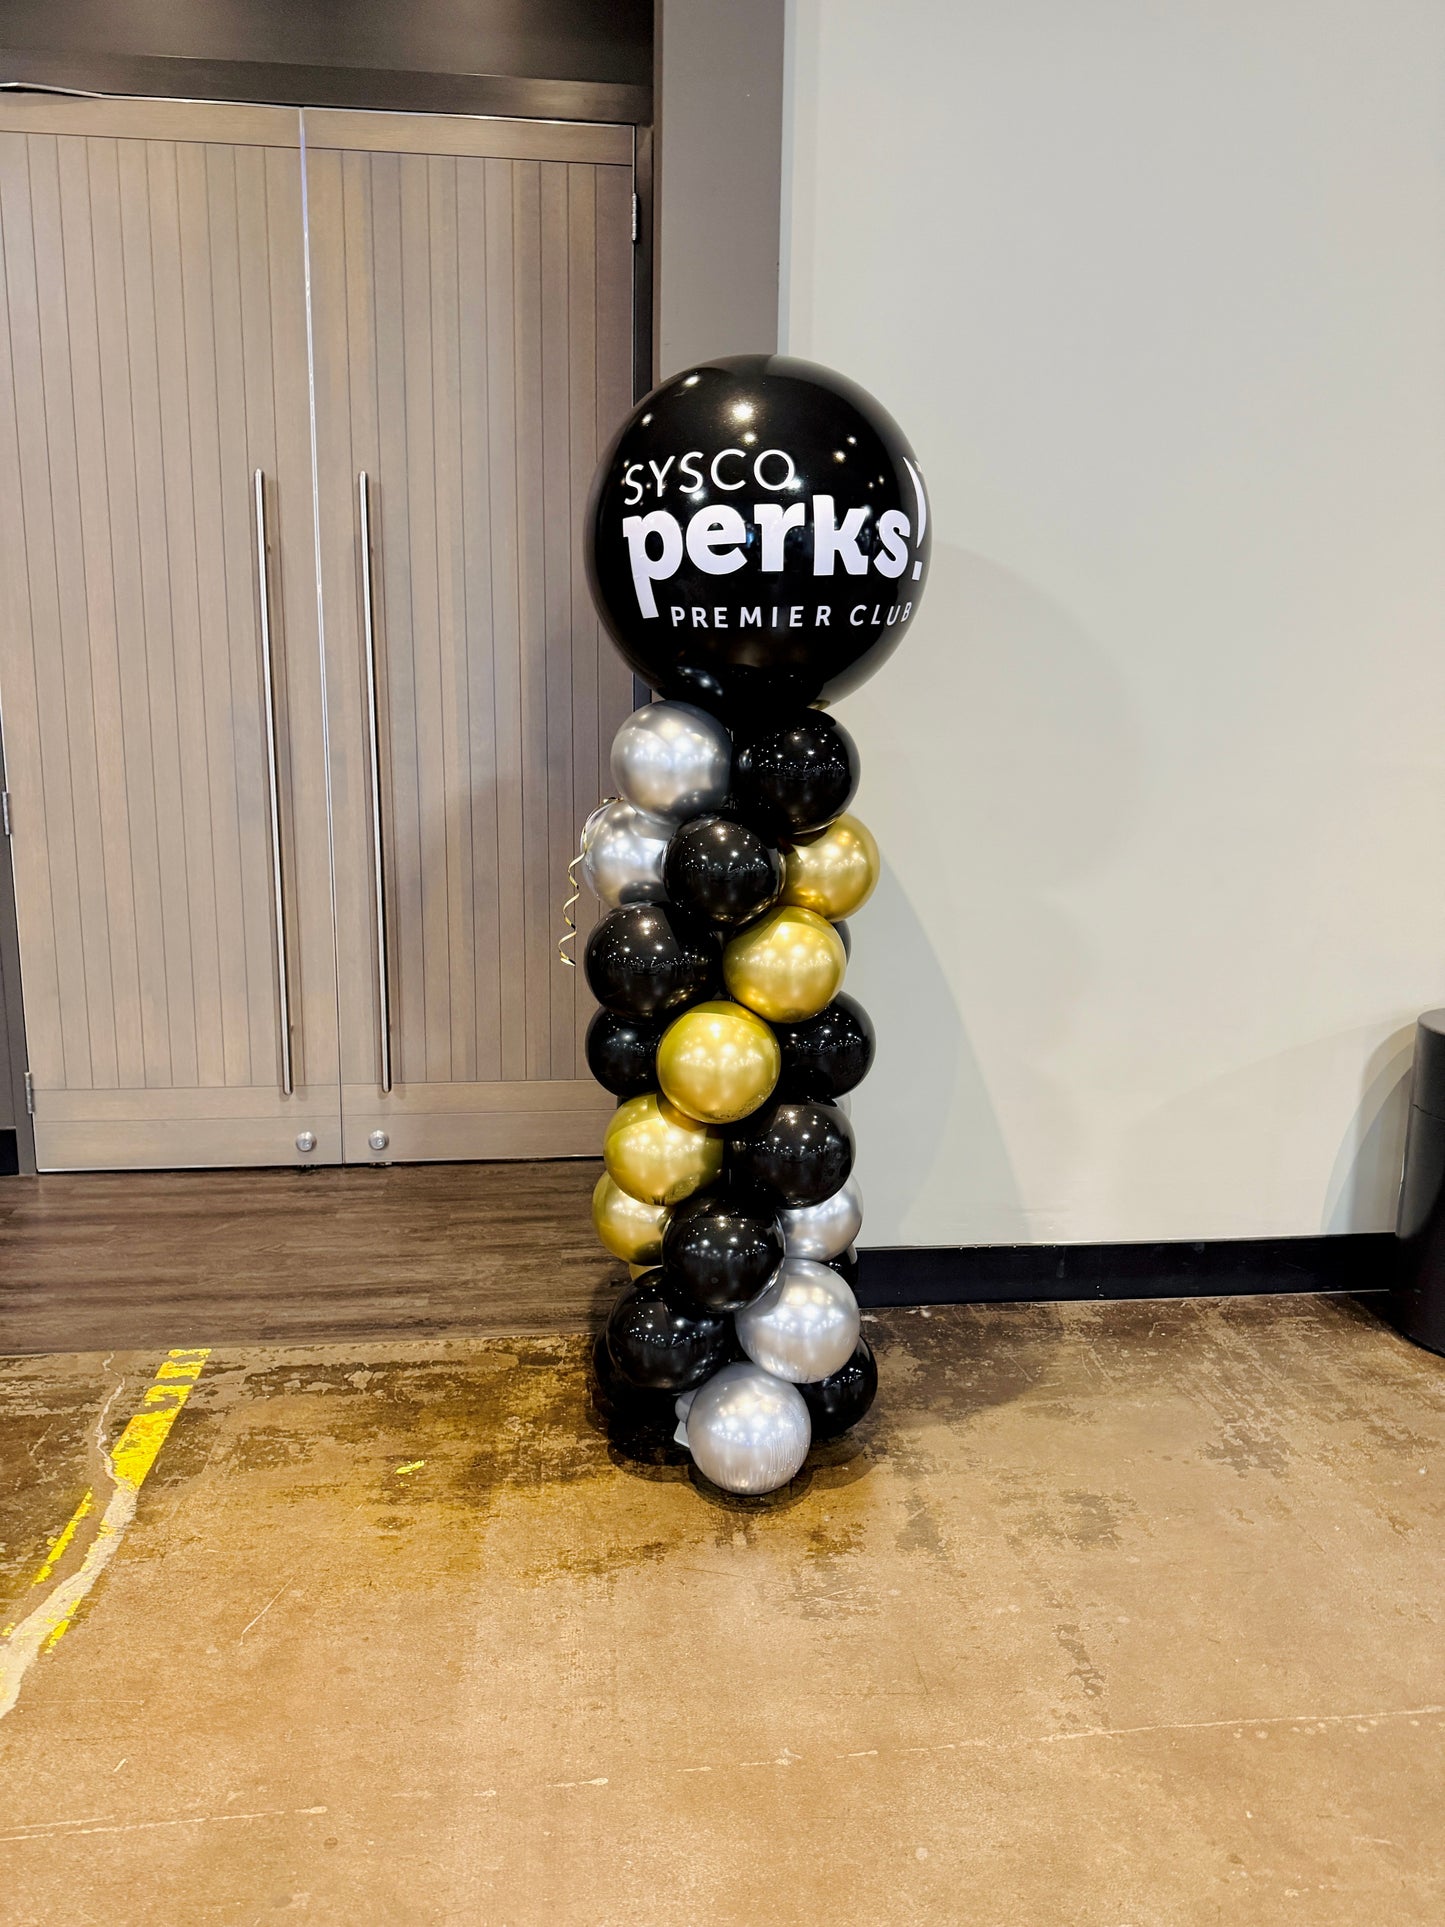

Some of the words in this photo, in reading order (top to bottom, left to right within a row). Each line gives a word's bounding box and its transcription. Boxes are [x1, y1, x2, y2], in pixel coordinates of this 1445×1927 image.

[624, 449, 795, 505] SYSCO
[623, 457, 926, 619] perks!
[670, 606, 832, 628] PREMIER
[850, 602, 912, 627] CLUB
